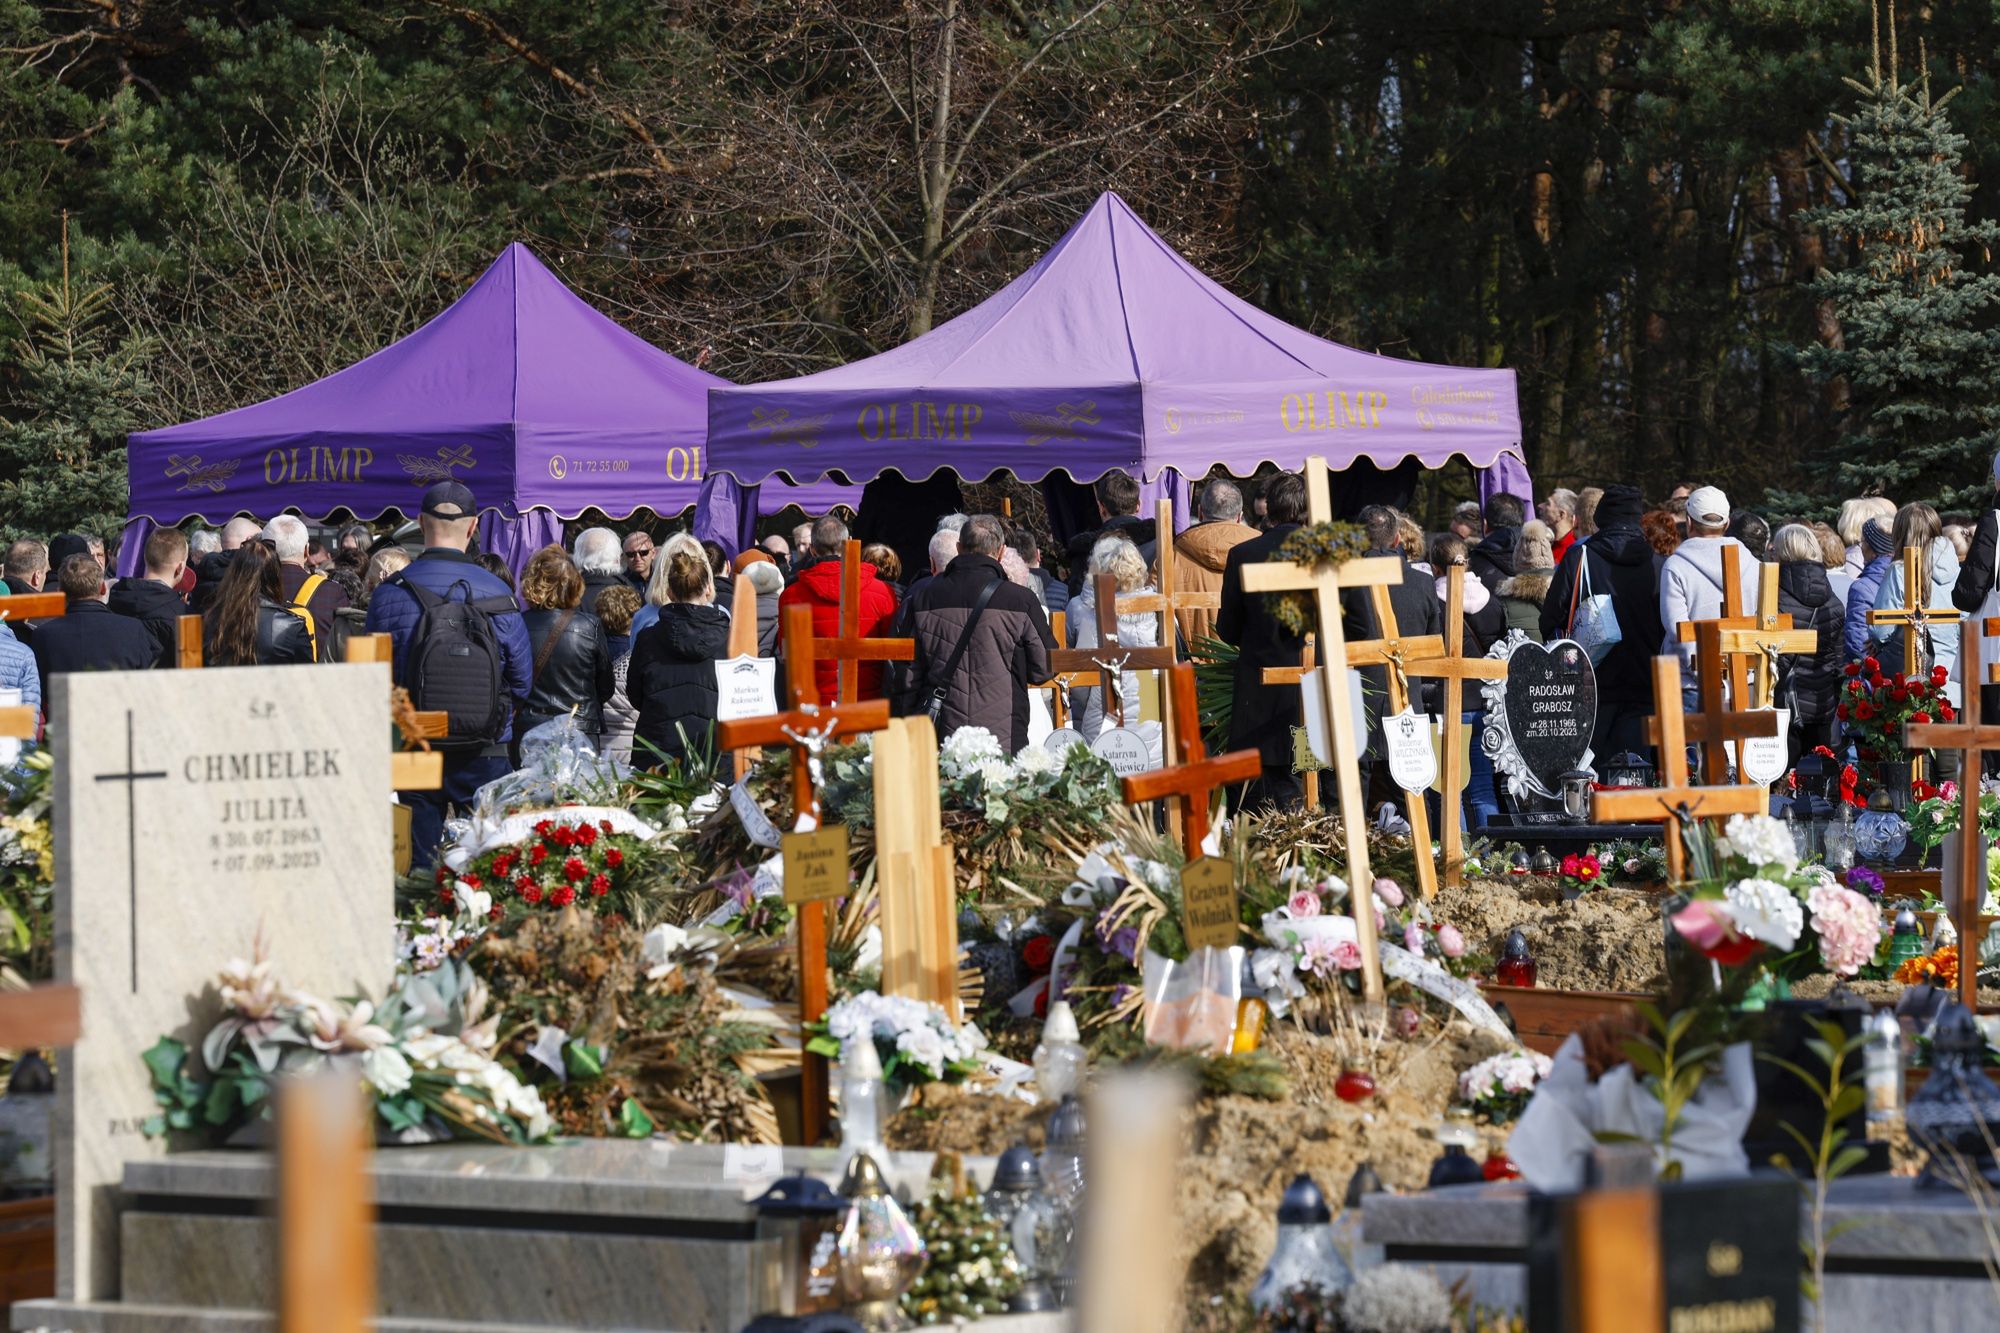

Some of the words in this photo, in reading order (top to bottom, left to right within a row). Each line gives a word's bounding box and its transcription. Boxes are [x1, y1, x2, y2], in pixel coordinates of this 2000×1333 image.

[1280, 390, 1388, 433] OLIMP
[857, 402, 983, 443] OLIMP
[263, 445, 374, 485] OLIMP
[572, 460, 583, 473] 71
[587, 460, 597, 472] 72
[599, 460, 610, 472] 55
[613, 459, 629, 472] 000
[1529, 684, 1575, 697] RADOSŁAW
[1532, 701, 1573, 713] GRABOSZ
[1526, 727, 1578, 738] zm.20.10.2023
[1102, 749, 1137, 761] Katarzyna
[184, 749, 340, 784] CHMIELEK
[220, 797, 308, 824] JULITA
